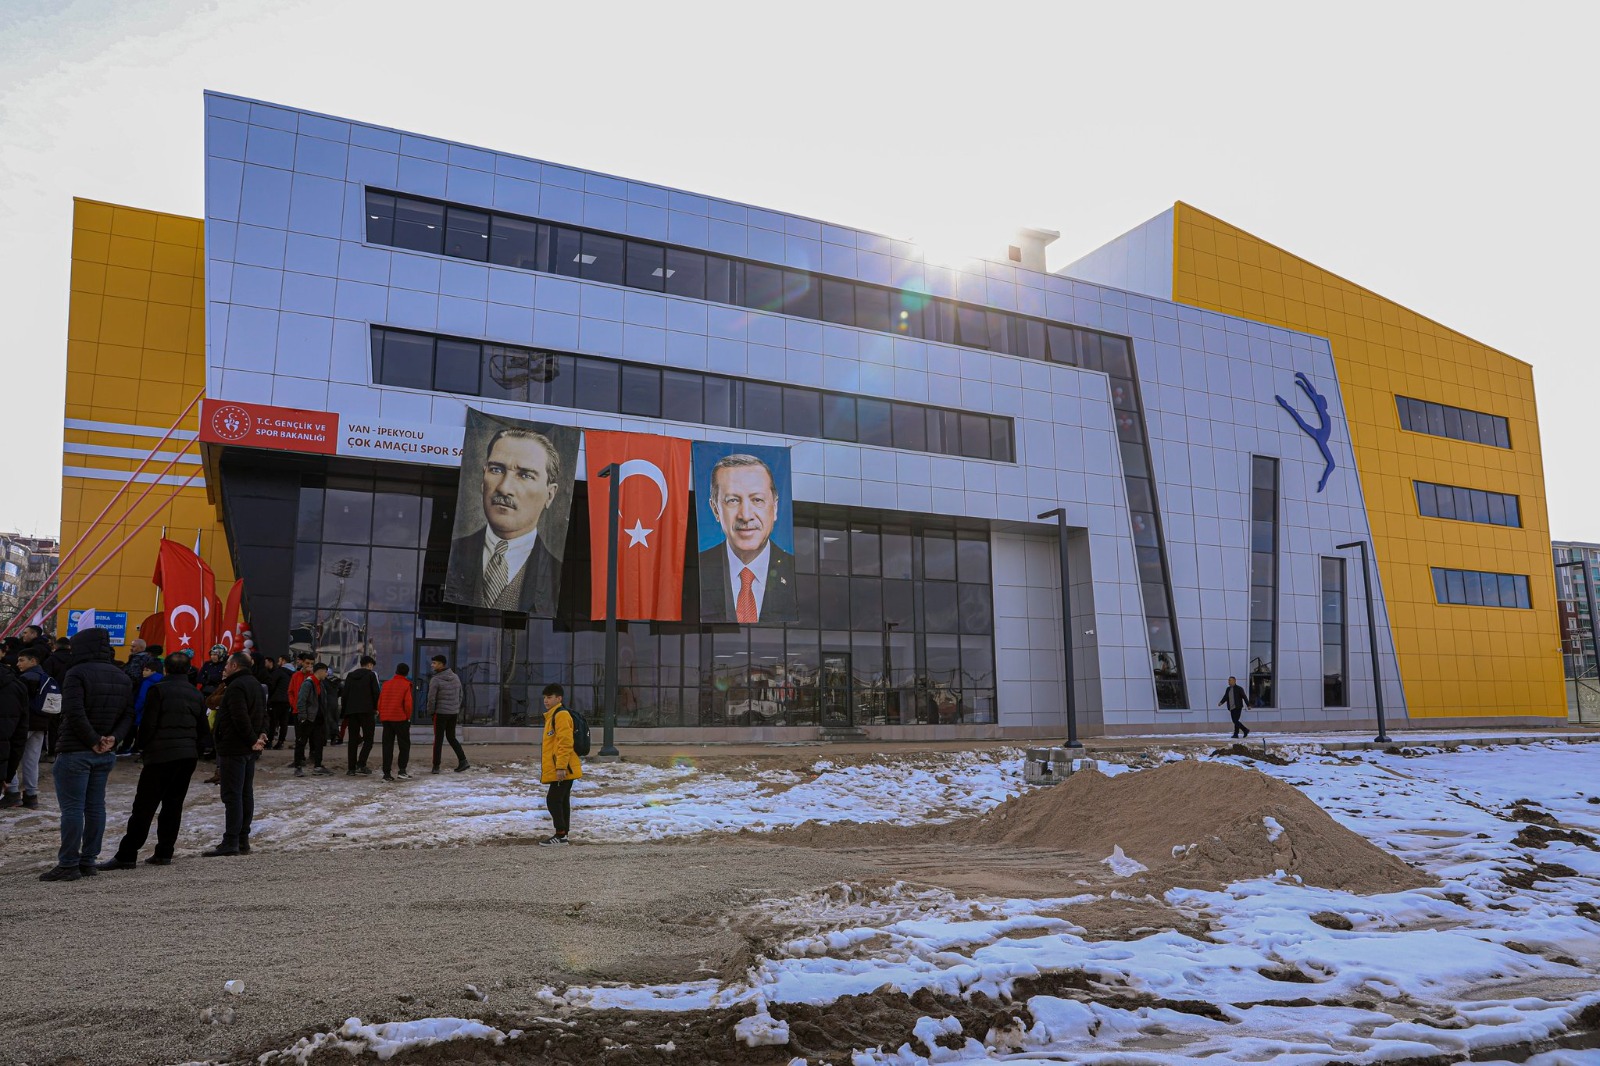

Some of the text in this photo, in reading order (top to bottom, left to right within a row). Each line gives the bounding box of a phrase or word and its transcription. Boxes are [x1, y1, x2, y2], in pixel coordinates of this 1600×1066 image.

[257, 418, 272, 426] T.C.
[275, 420, 312, 430] GENÇLİK
[256, 428, 326, 441] SPOR BAKANLIĞI
[348, 424, 370, 434] VAN
[377, 425, 424, 440] İPEKYOLU
[347, 437, 371, 448] ÇOK
[374, 440, 418, 454] AMAÇLI
[420, 444, 449, 456] SPOR
